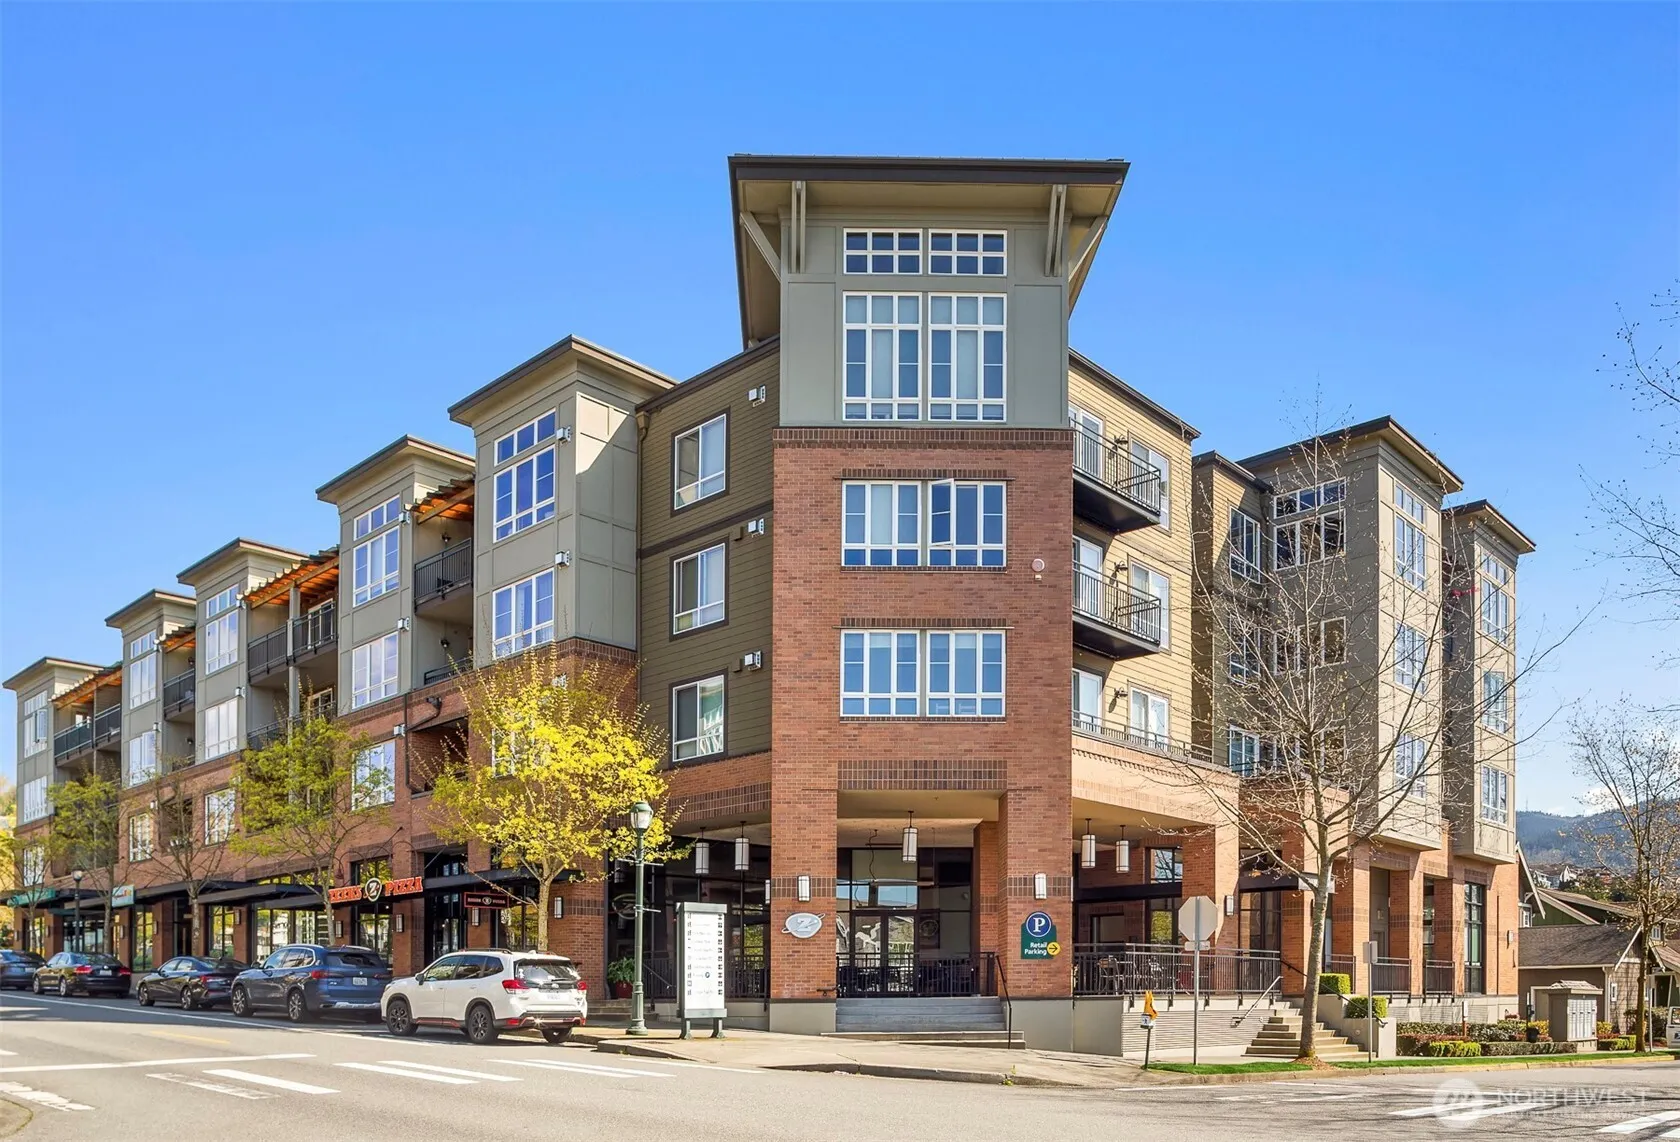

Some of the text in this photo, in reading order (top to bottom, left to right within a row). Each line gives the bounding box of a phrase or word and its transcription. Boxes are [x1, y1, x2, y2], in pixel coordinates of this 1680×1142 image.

[385, 876, 423, 896] PIZZA
[1032, 917, 1046, 933] P
[1024, 948, 1047, 956] Parking
